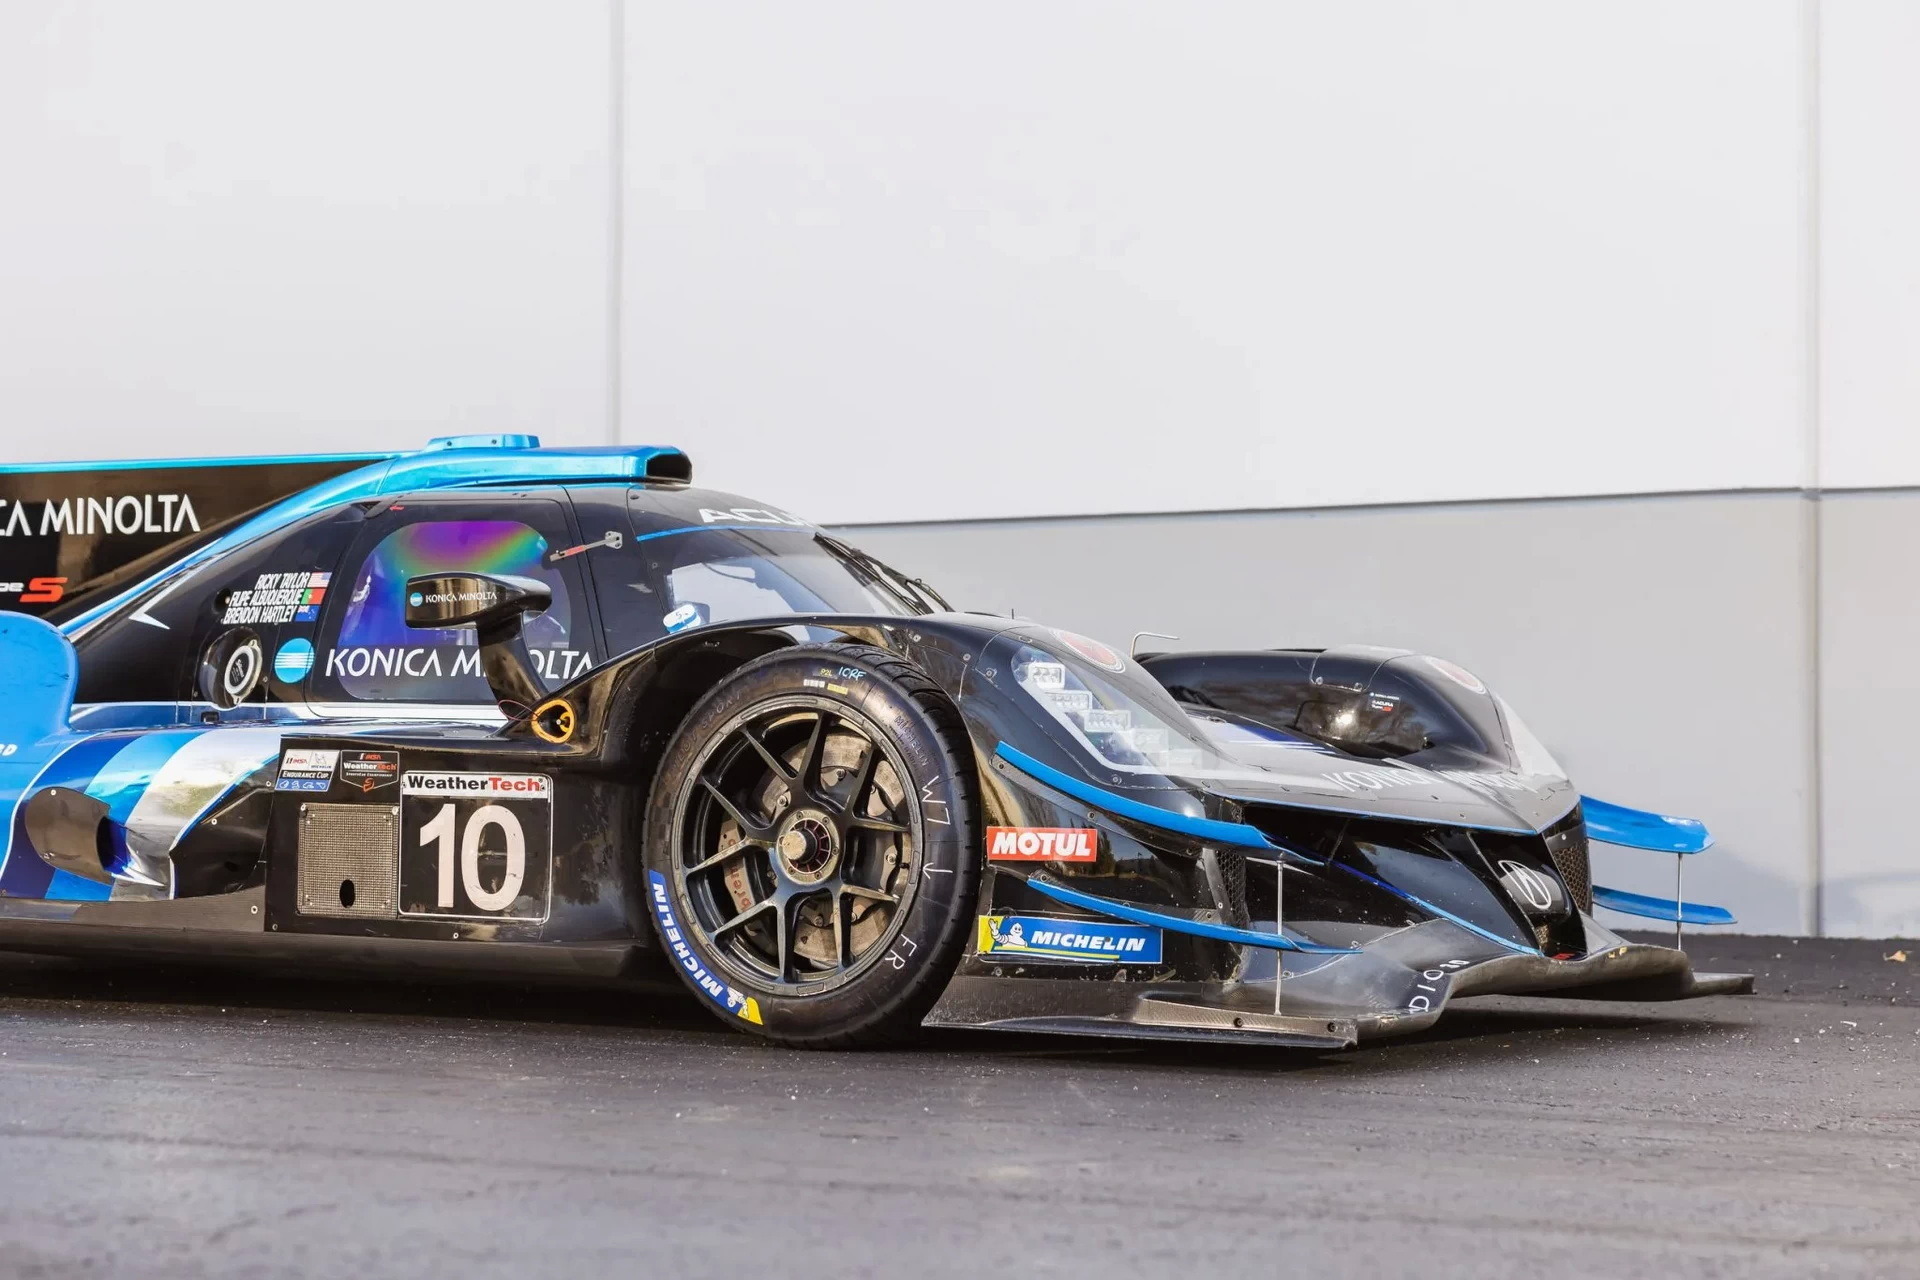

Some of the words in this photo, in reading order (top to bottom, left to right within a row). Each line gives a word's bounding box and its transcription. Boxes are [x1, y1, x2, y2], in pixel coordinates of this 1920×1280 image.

[0, 499, 32, 536] A
[39, 493, 201, 536] MINOLTA
[19, 577, 68, 603] S
[279, 571, 311, 589] TAYLOR
[249, 588, 305, 605] ALBUQUERQUE
[425, 594, 456, 603] KONICA
[458, 591, 498, 602] MINOLTA
[222, 606, 262, 624] BRENDON
[259, 605, 298, 623] HARTLEY
[325, 648, 443, 677] KONICA
[450, 648, 596, 680] MOLTA
[343, 762, 397, 770] WeatherTech
[408, 775, 541, 792] WeatherTech
[992, 832, 1092, 857] MOTUL
[420, 803, 526, 912] 10
[653, 882, 724, 998] MICHELIN
[1031, 930, 1147, 951] MICHELIN
